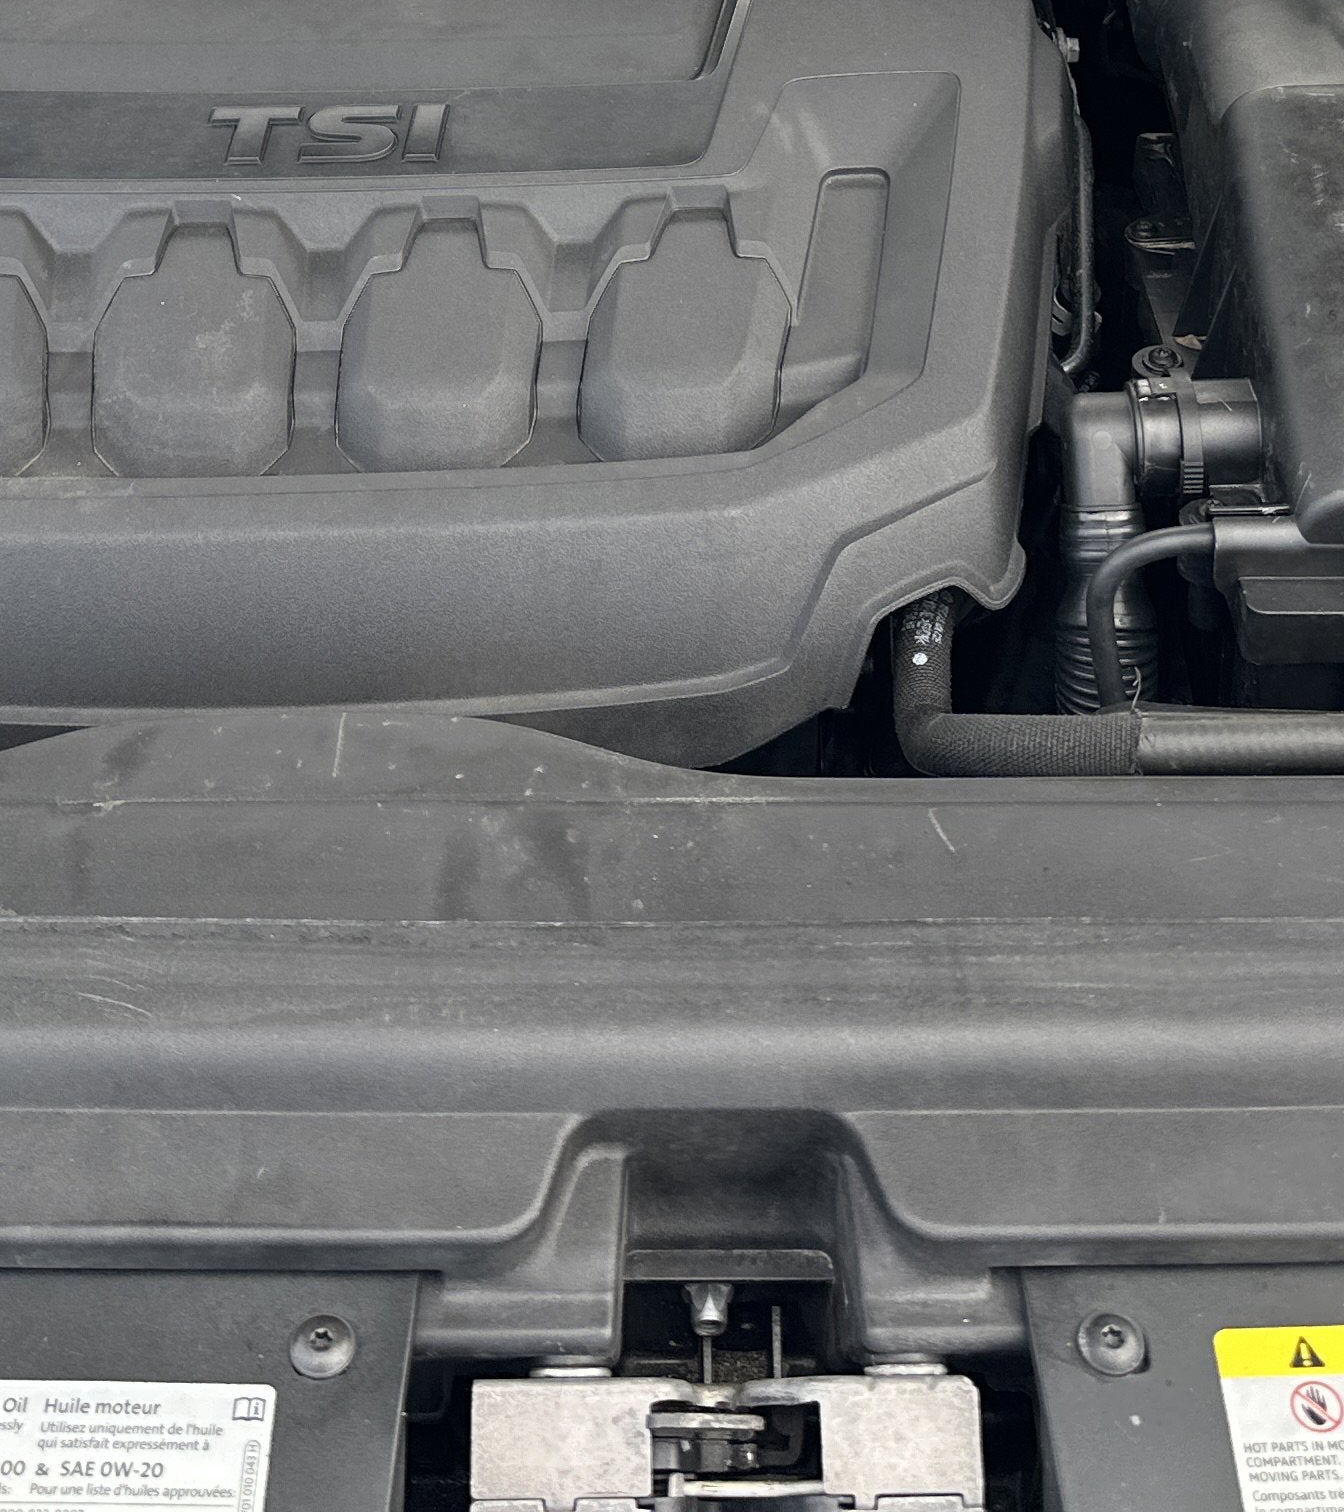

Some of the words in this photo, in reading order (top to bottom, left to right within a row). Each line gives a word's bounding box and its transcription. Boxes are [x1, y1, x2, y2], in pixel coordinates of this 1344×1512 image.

[207, 103, 451, 164] TSI
[2, 1397, 29, 1413] Oil
[43, 1397, 91, 1414] Huile
[94, 1399, 162, 1416] moteur
[40, 1421, 86, 1434] Utilisez
[88, 1422, 165, 1437] uniquement
[167, 1423, 183, 1436] de
[185, 1424, 224, 1437] l'huile
[37, 1438, 58, 1451] qui
[60, 1436, 110, 1450] satisfait
[112, 1438, 199, 1453] expressément
[1244, 1442, 1268, 1453] HOT
[1271, 1441, 1309, 1453] PARTS
[1246, 1454, 1342, 1468] COMPARTMENT.
[0, 1460, 27, 1476] 00
[35, 1463, 50, 1477] &
[59, 1460, 97, 1478] SAE
[100, 1461, 165, 1479] 0W-20
[1249, 1470, 1299, 1482] MOVING
[30, 1482, 58, 1496] Pour
[85, 1483, 112, 1497] liste
[113, 1484, 161, 1498] d'huiles
[1252, 1489, 1326, 1503] Composants
